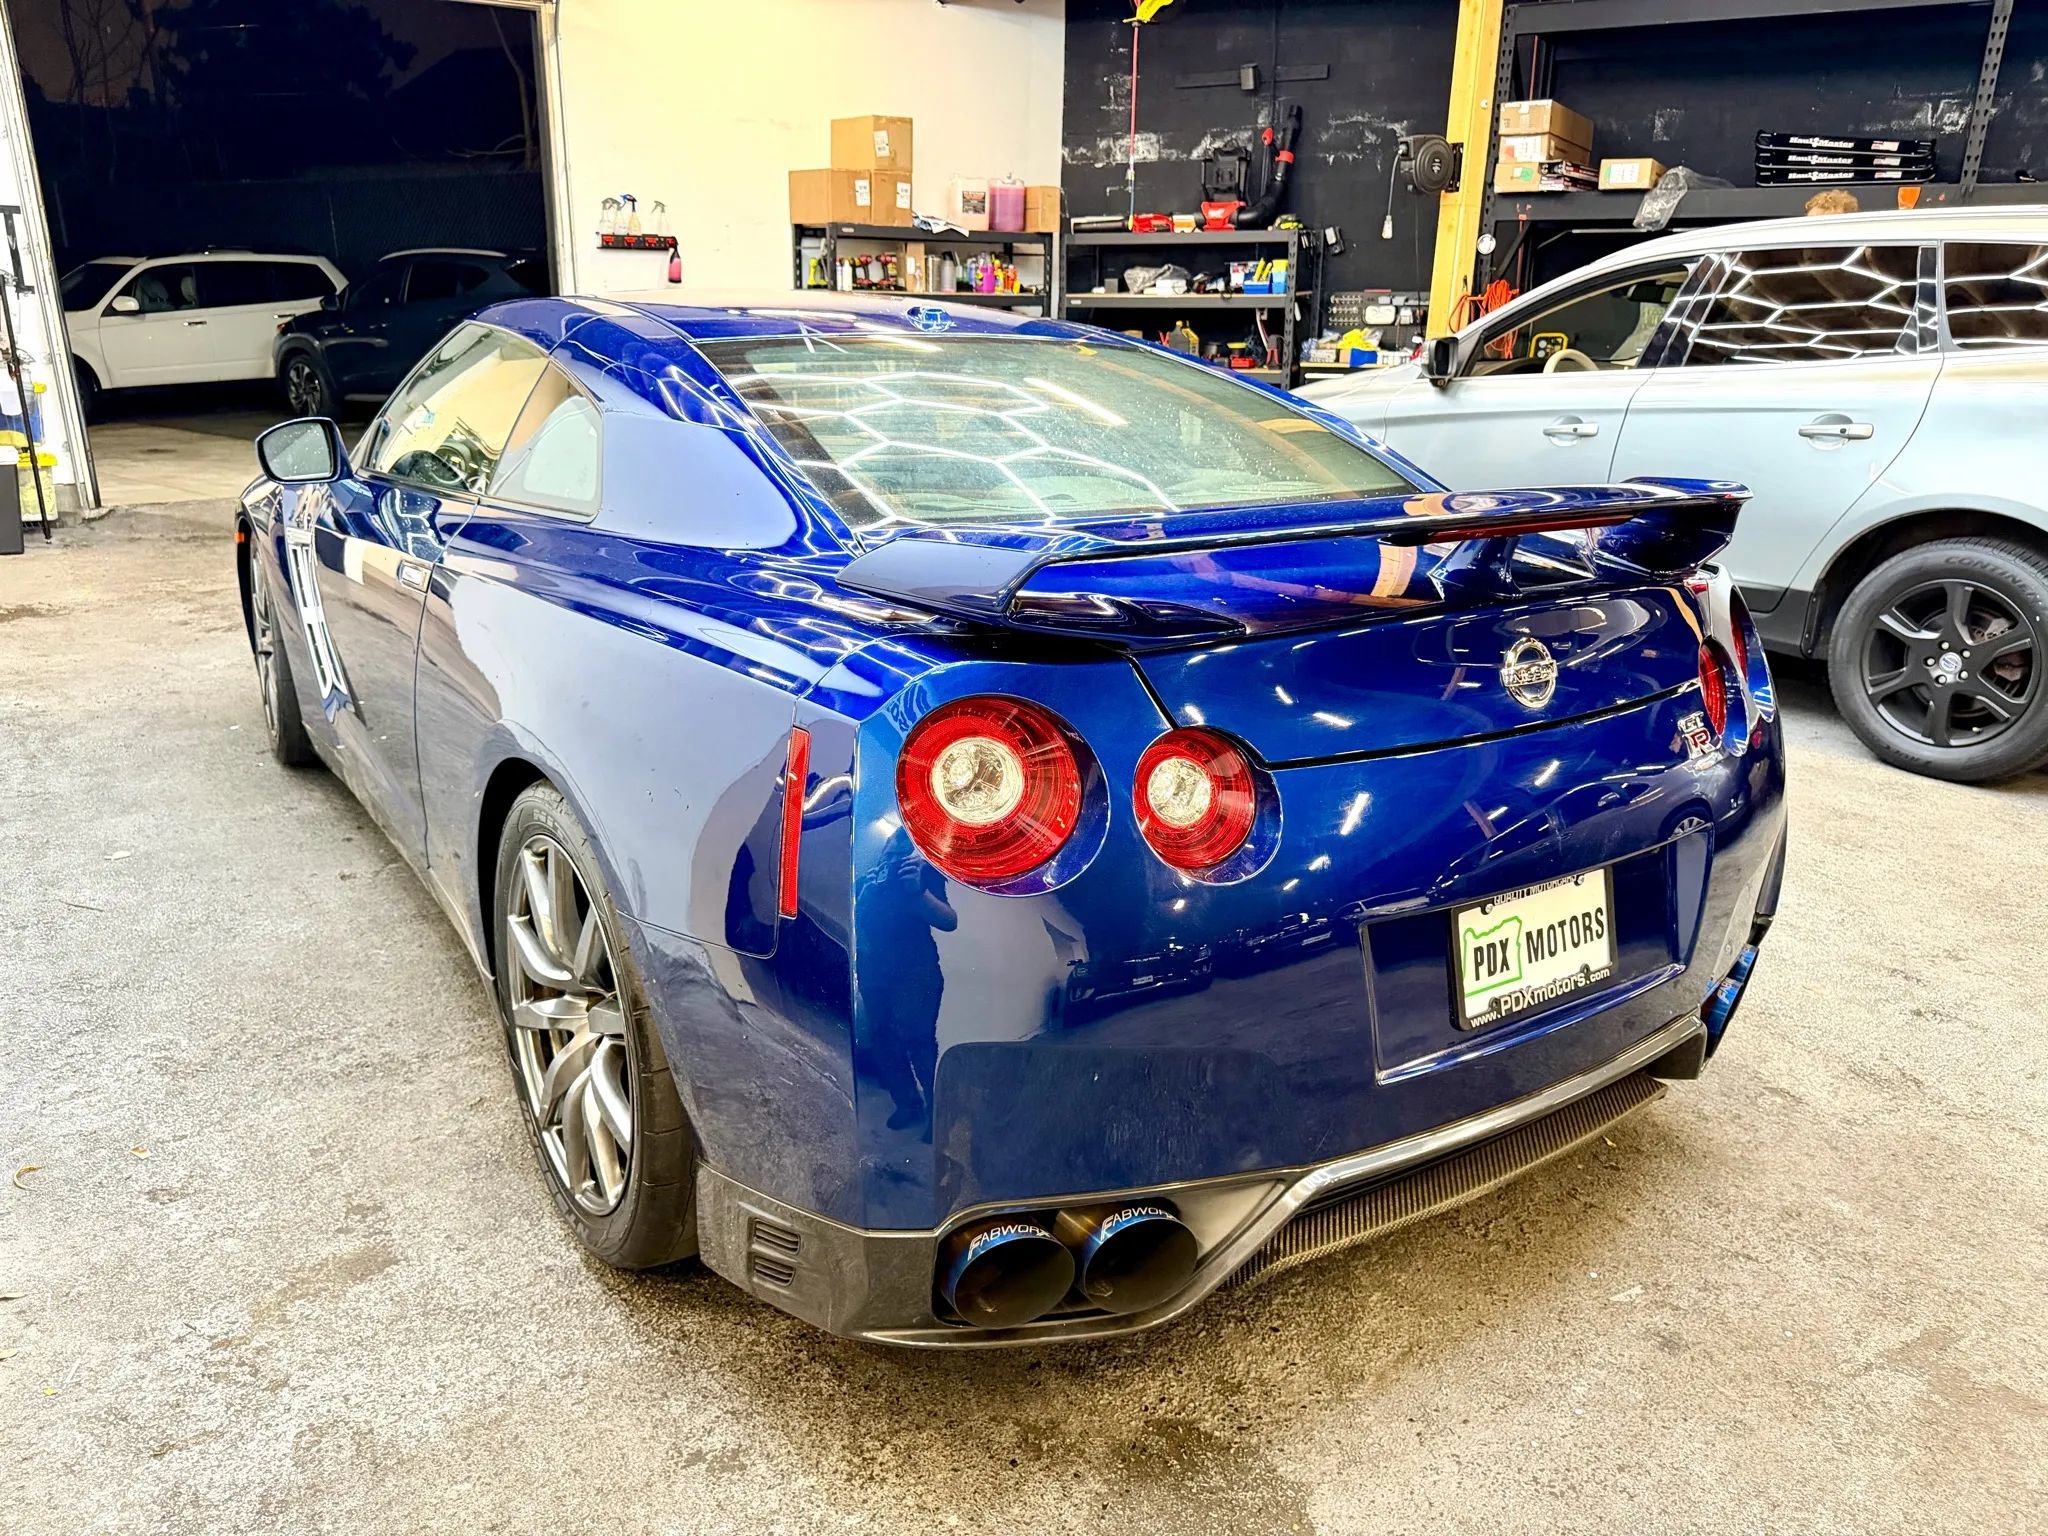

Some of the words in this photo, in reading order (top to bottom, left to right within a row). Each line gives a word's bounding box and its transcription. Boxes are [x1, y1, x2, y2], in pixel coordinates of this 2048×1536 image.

[1510, 662, 1557, 685] NISSAN
[1473, 937, 1510, 982] PDX
[1525, 907, 1605, 964] MOTORS
[1470, 968, 1610, 1028] www.PDXmotors.com
[967, 1224, 1051, 1261] FABWORX
